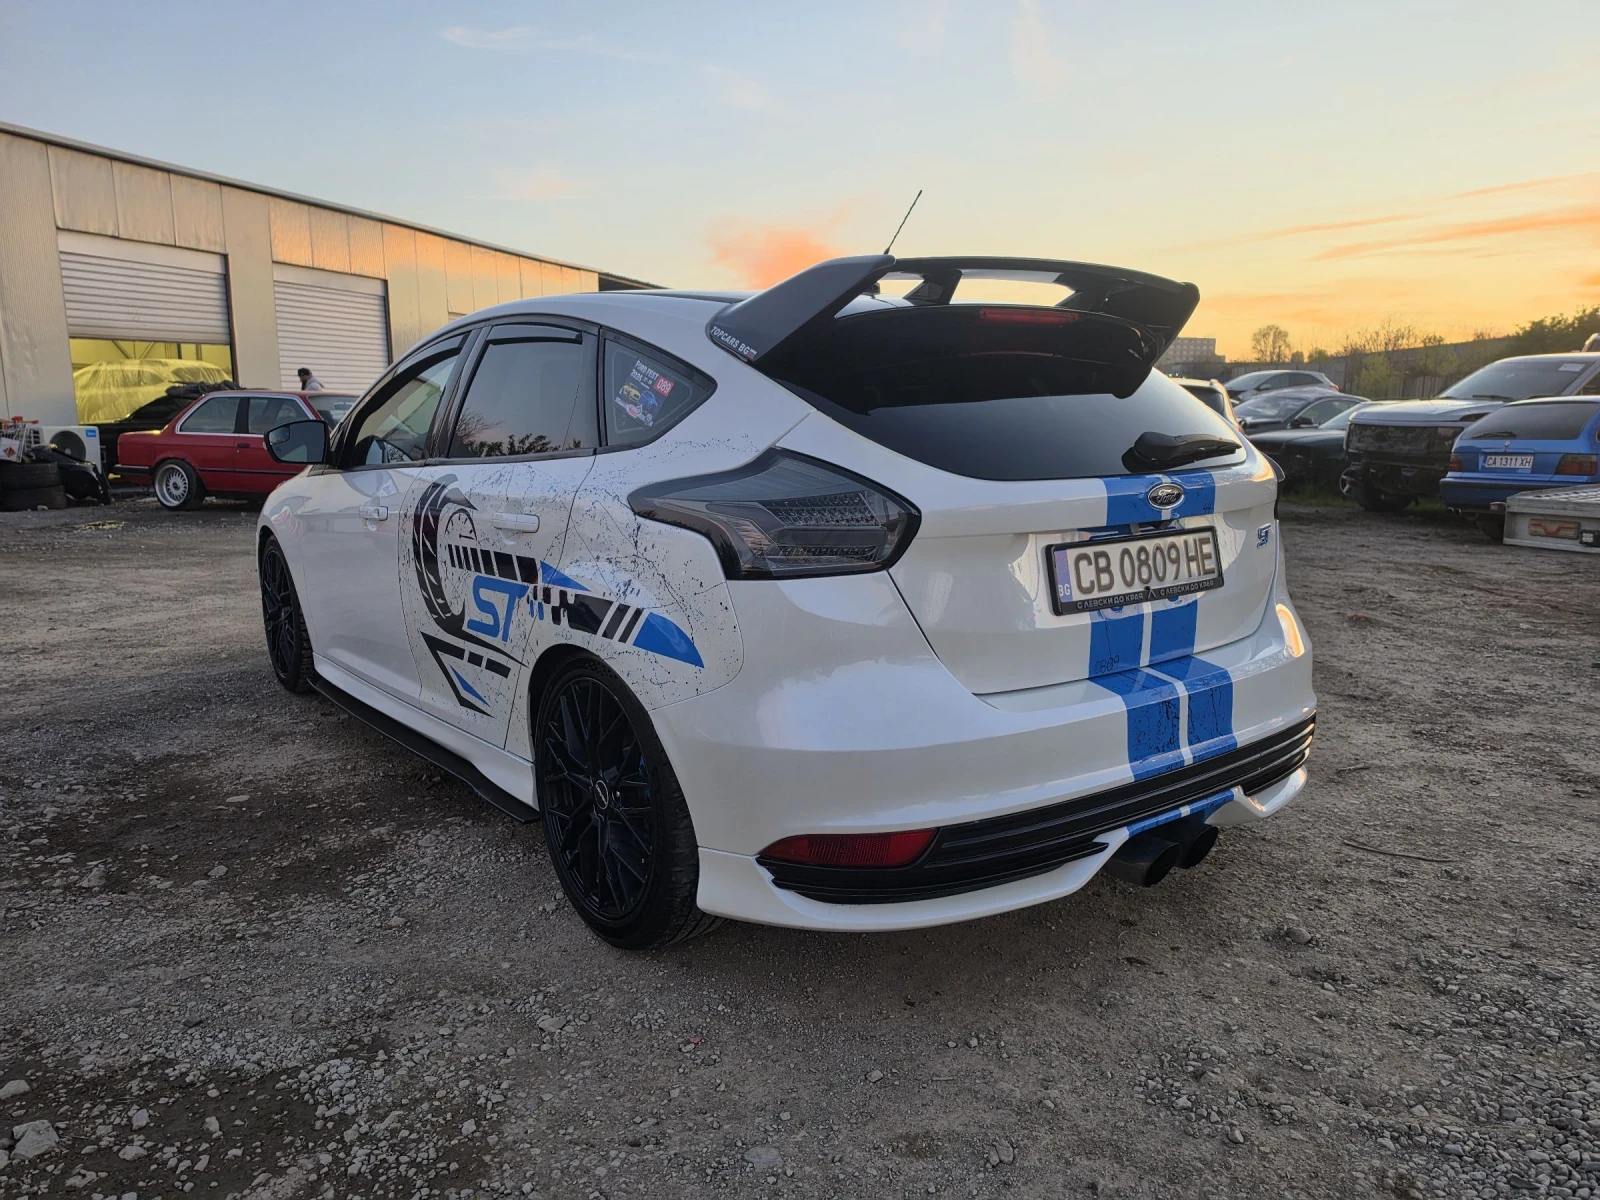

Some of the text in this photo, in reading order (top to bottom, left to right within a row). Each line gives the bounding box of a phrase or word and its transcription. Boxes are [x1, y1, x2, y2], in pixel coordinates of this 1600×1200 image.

[711, 325, 750, 355] TOPCARS BG
[646, 367, 660, 380] FEST
[656, 378, 672, 394] 089
[1500, 457, 1518, 467] 1311
[1074, 536, 1216, 595] CB 0809 HE
[1058, 583, 1071, 597] BG
